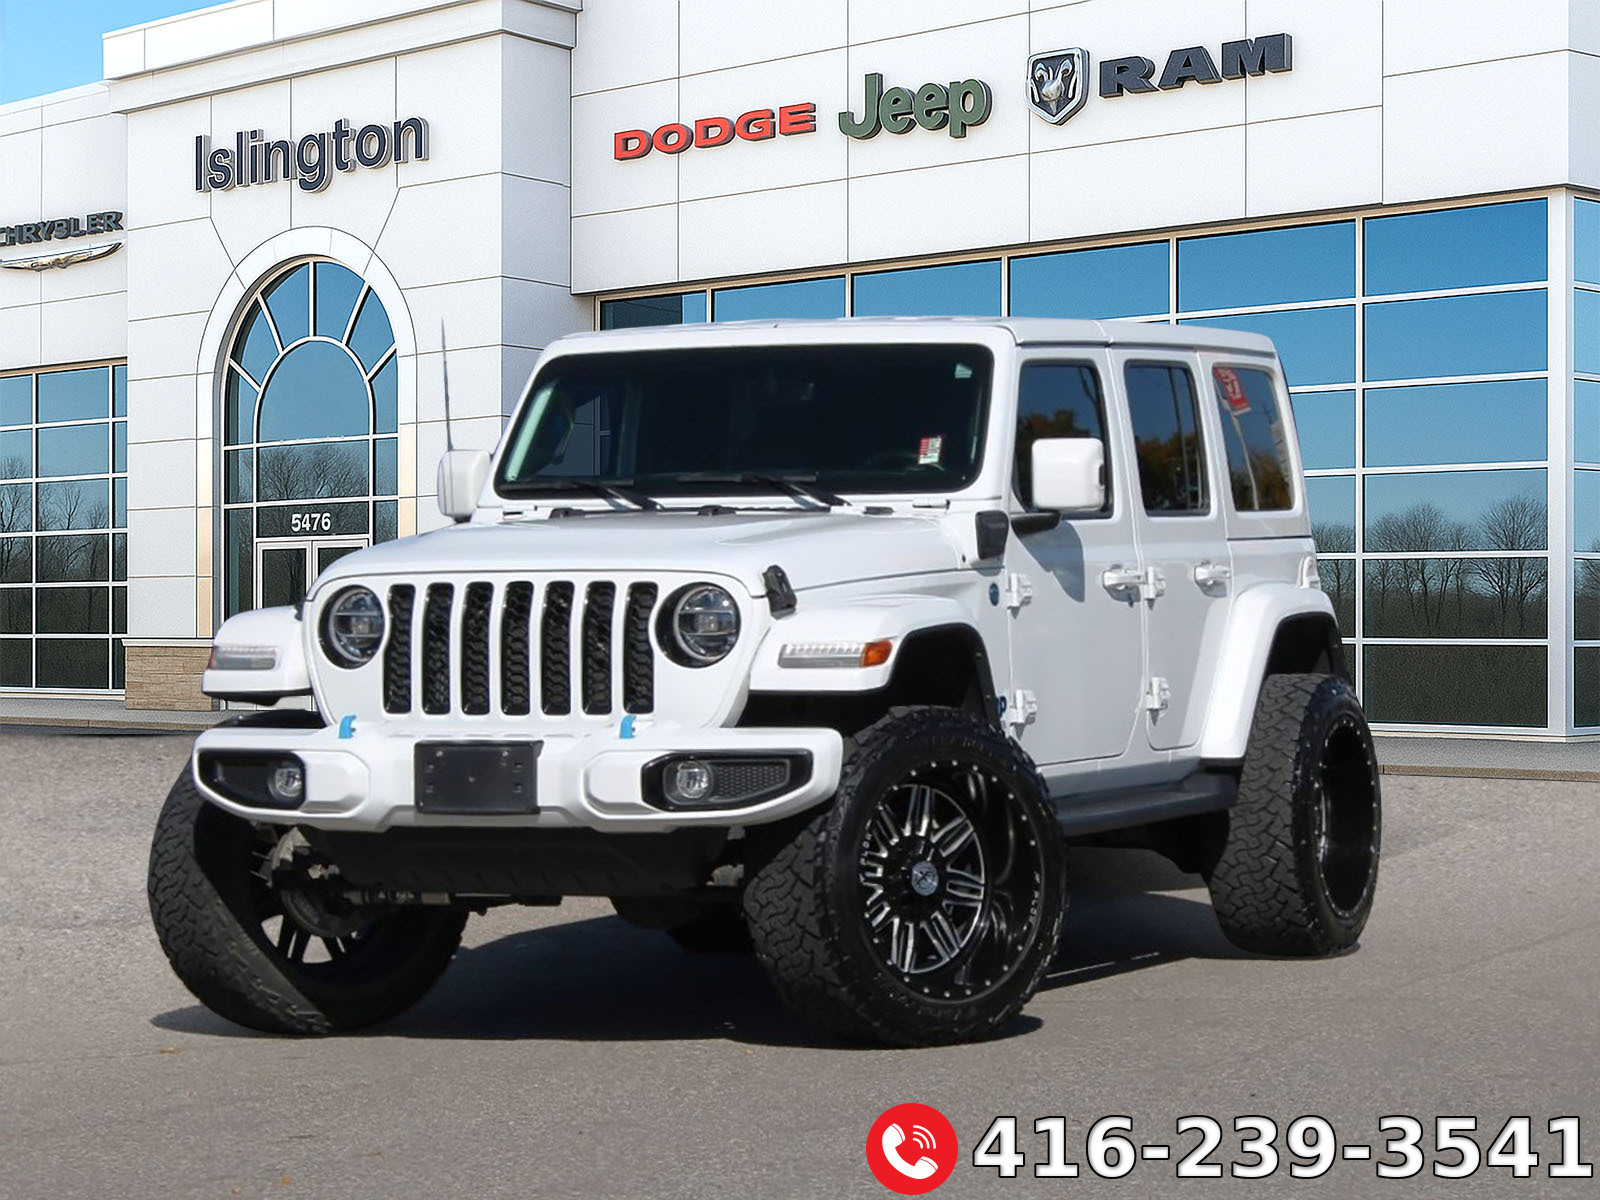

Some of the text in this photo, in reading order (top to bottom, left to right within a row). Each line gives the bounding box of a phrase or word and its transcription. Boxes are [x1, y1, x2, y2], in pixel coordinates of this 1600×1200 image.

[1099, 33, 1292, 98] RAM
[614, 102, 816, 161] DODGE
[838, 72, 993, 139] Jeep
[195, 116, 430, 192] Islington
[291, 512, 331, 532] 5476
